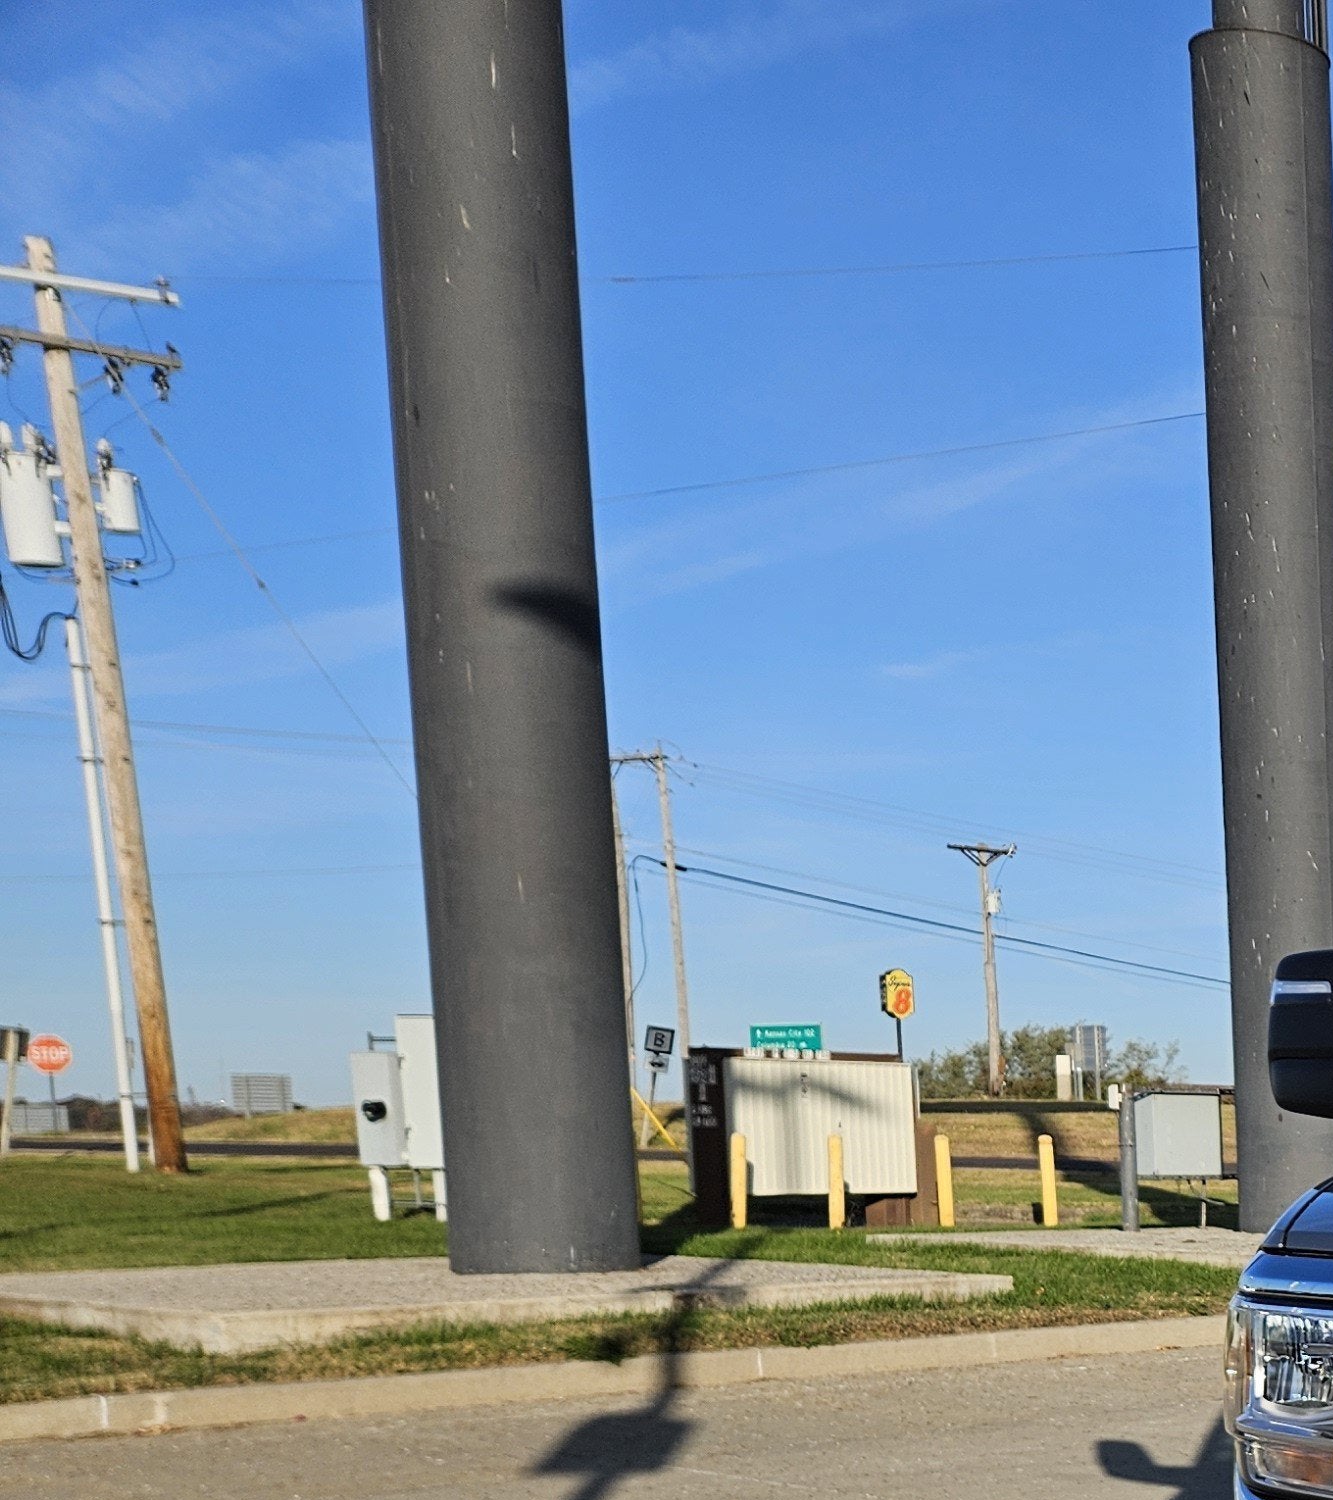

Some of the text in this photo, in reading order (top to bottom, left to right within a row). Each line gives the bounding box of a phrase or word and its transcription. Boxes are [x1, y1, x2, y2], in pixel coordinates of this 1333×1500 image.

[893, 988, 911, 1014] 8
[653, 1032, 665, 1047] B
[31, 1045, 69, 1062] STOP
